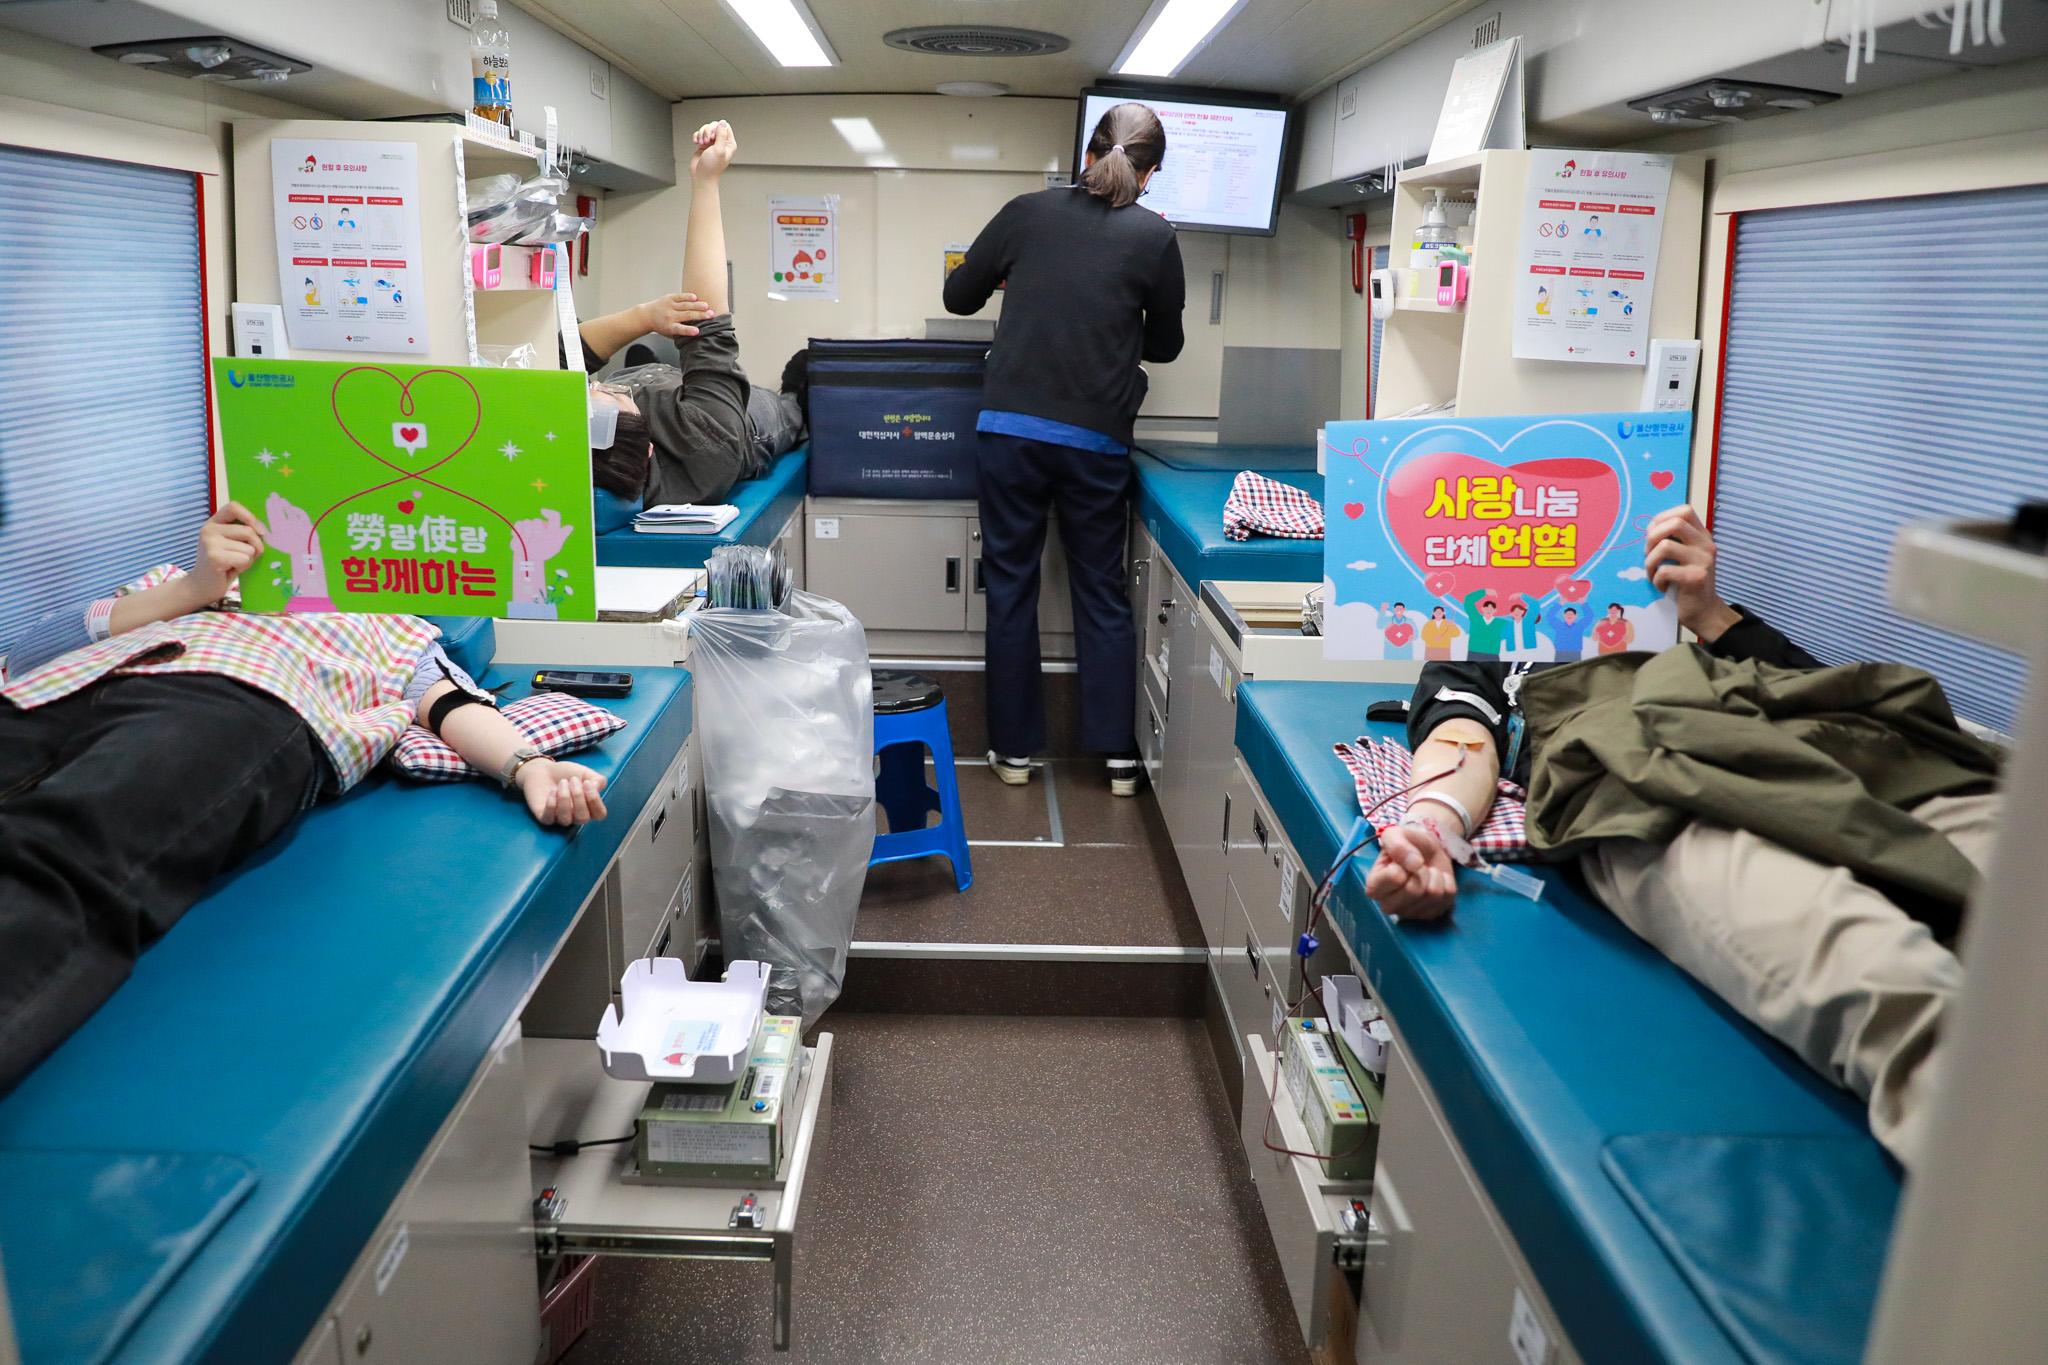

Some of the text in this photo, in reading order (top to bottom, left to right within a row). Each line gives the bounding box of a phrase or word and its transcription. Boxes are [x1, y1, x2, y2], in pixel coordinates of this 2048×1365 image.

[321, 163, 334, 171] 헌혈
[343, 164, 368, 173] 유의사항
[1579, 168, 1593, 177] 헌혈
[1602, 170, 1627, 179] 유의사항
[858, 430, 900, 440] 대한적십자사
[1424, 475, 1580, 520] 사랑나눔
[346, 512, 488, 554] 勞랑使랑
[1425, 523, 1578, 568] 단체헌혈
[341, 556, 497, 597] 함께하는
